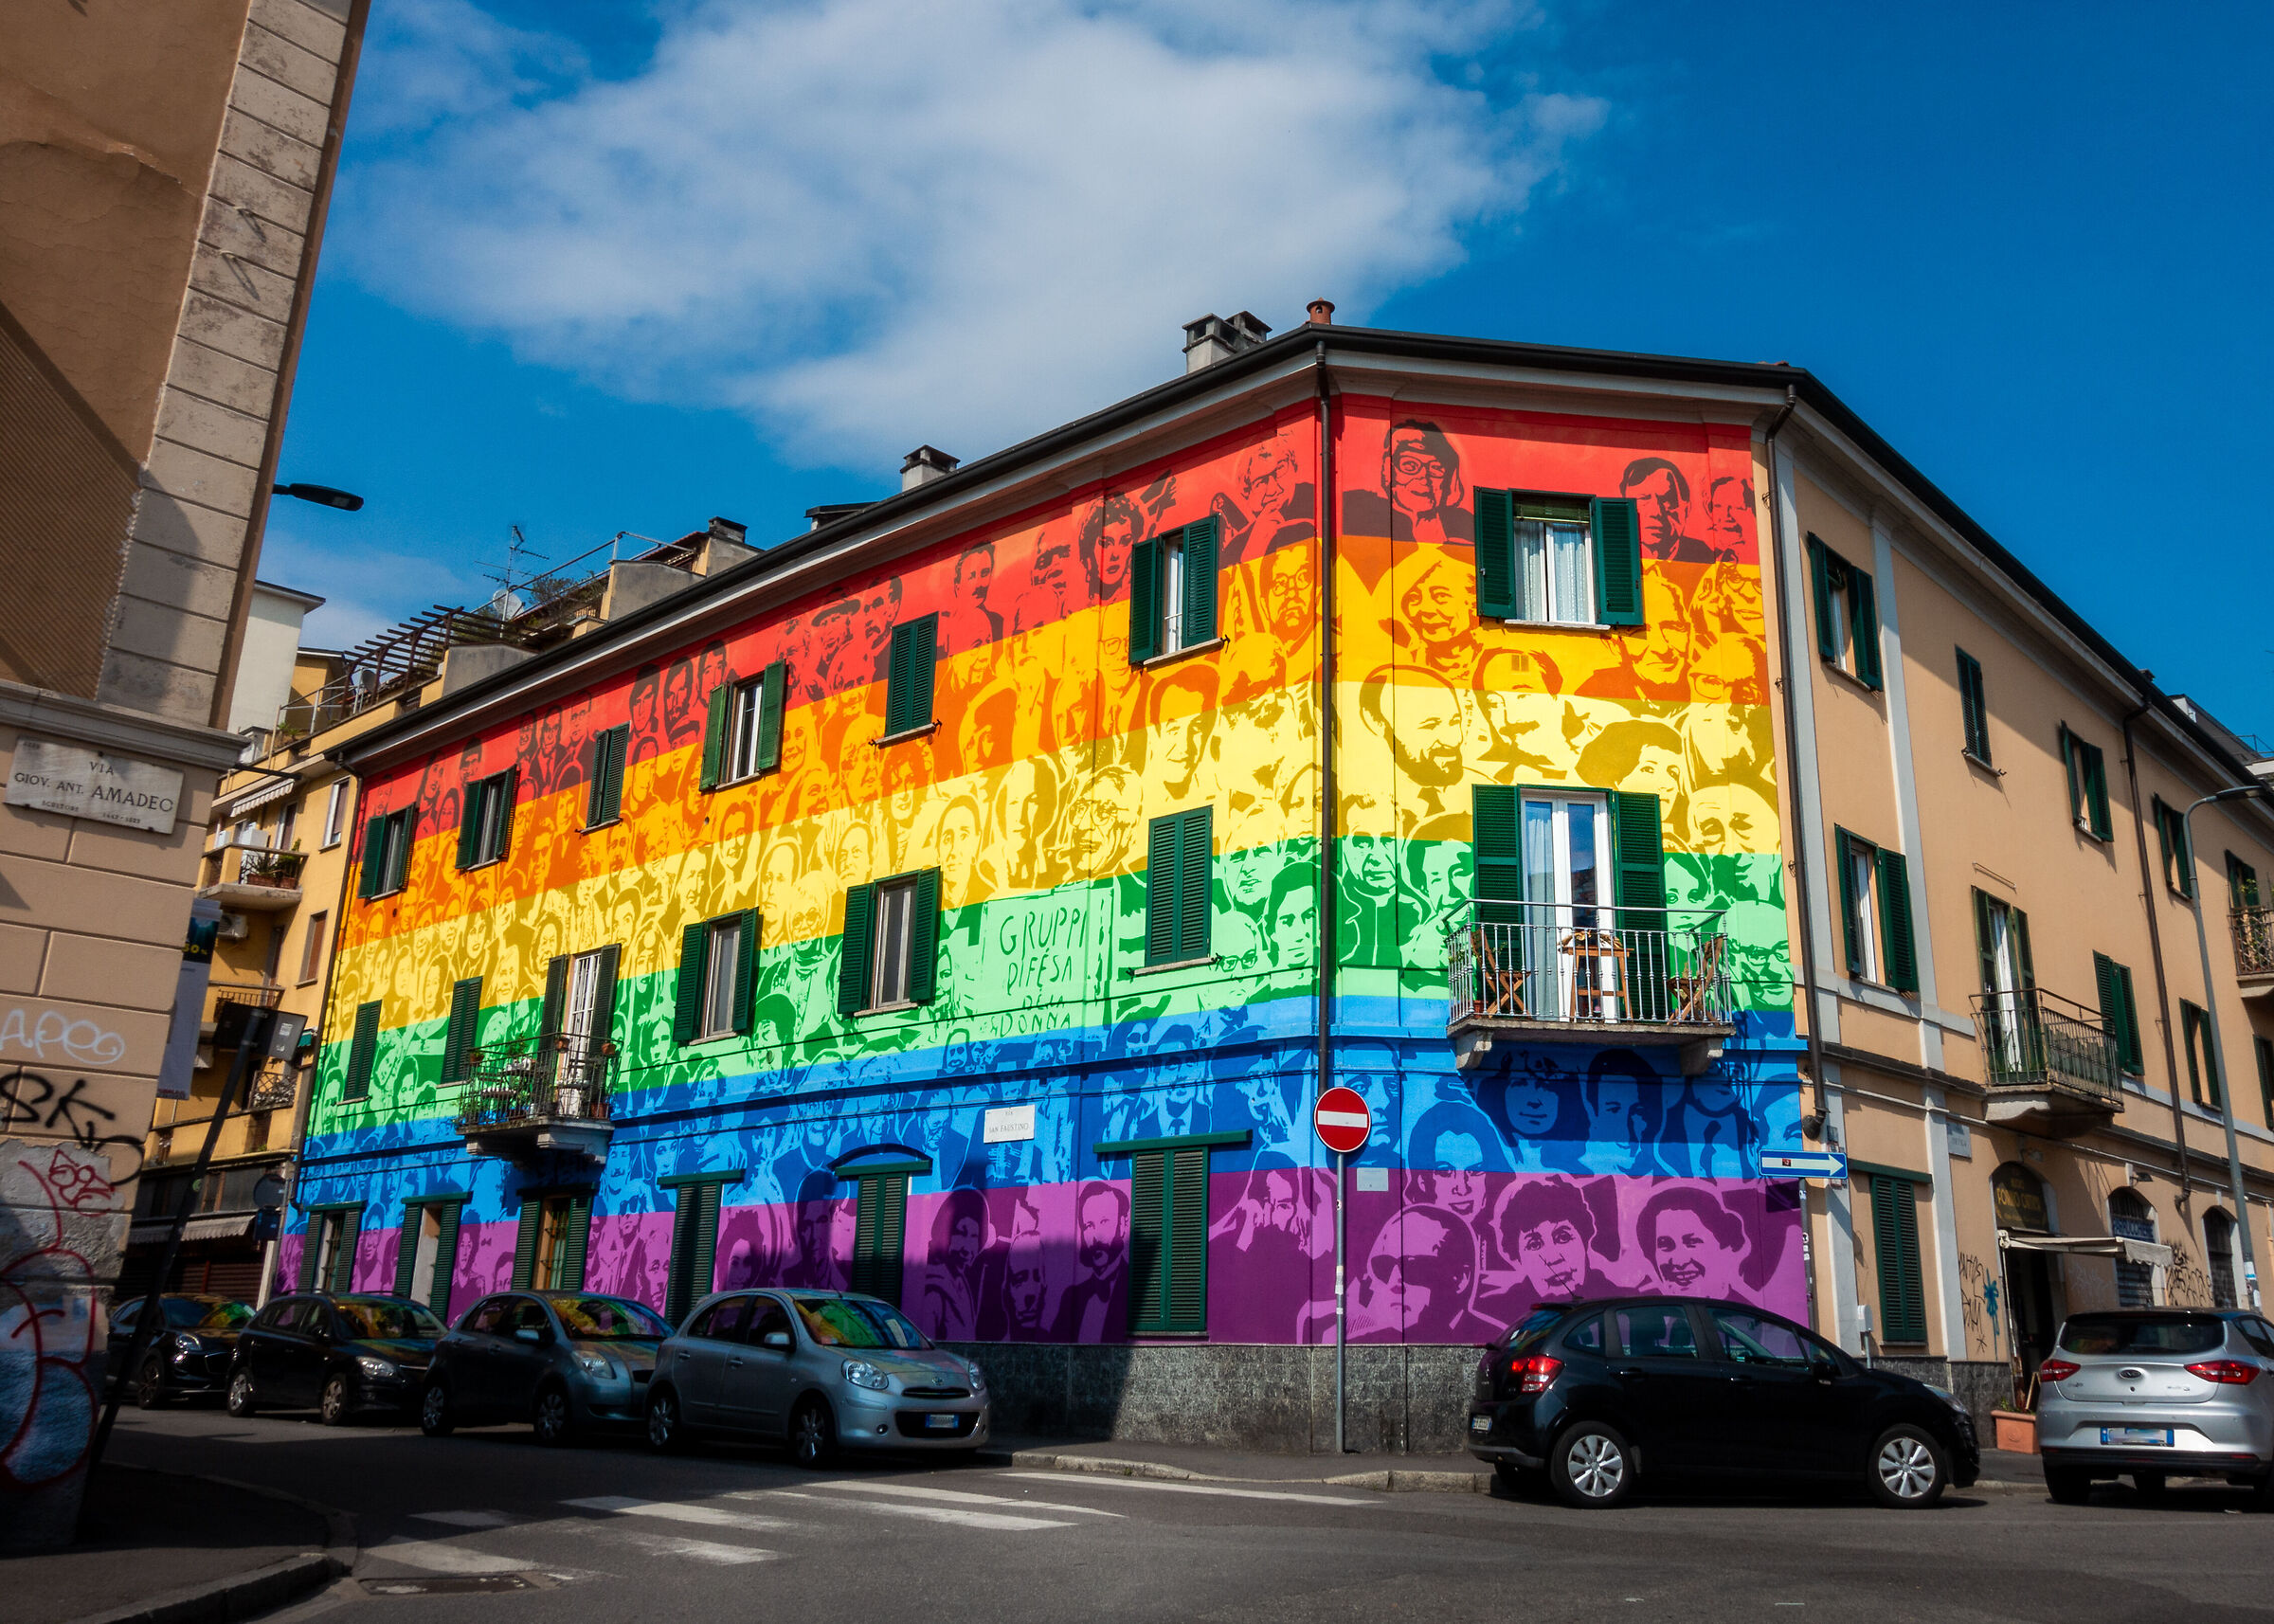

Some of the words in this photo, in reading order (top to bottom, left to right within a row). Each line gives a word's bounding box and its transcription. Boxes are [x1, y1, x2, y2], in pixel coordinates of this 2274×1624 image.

[89, 761, 115, 775] VIA
[14, 772, 50, 787] GIOV.
[56, 781, 84, 795] ANT.
[91, 785, 174, 812] AMADEO
[1000, 906, 1088, 960] GRUPPI
